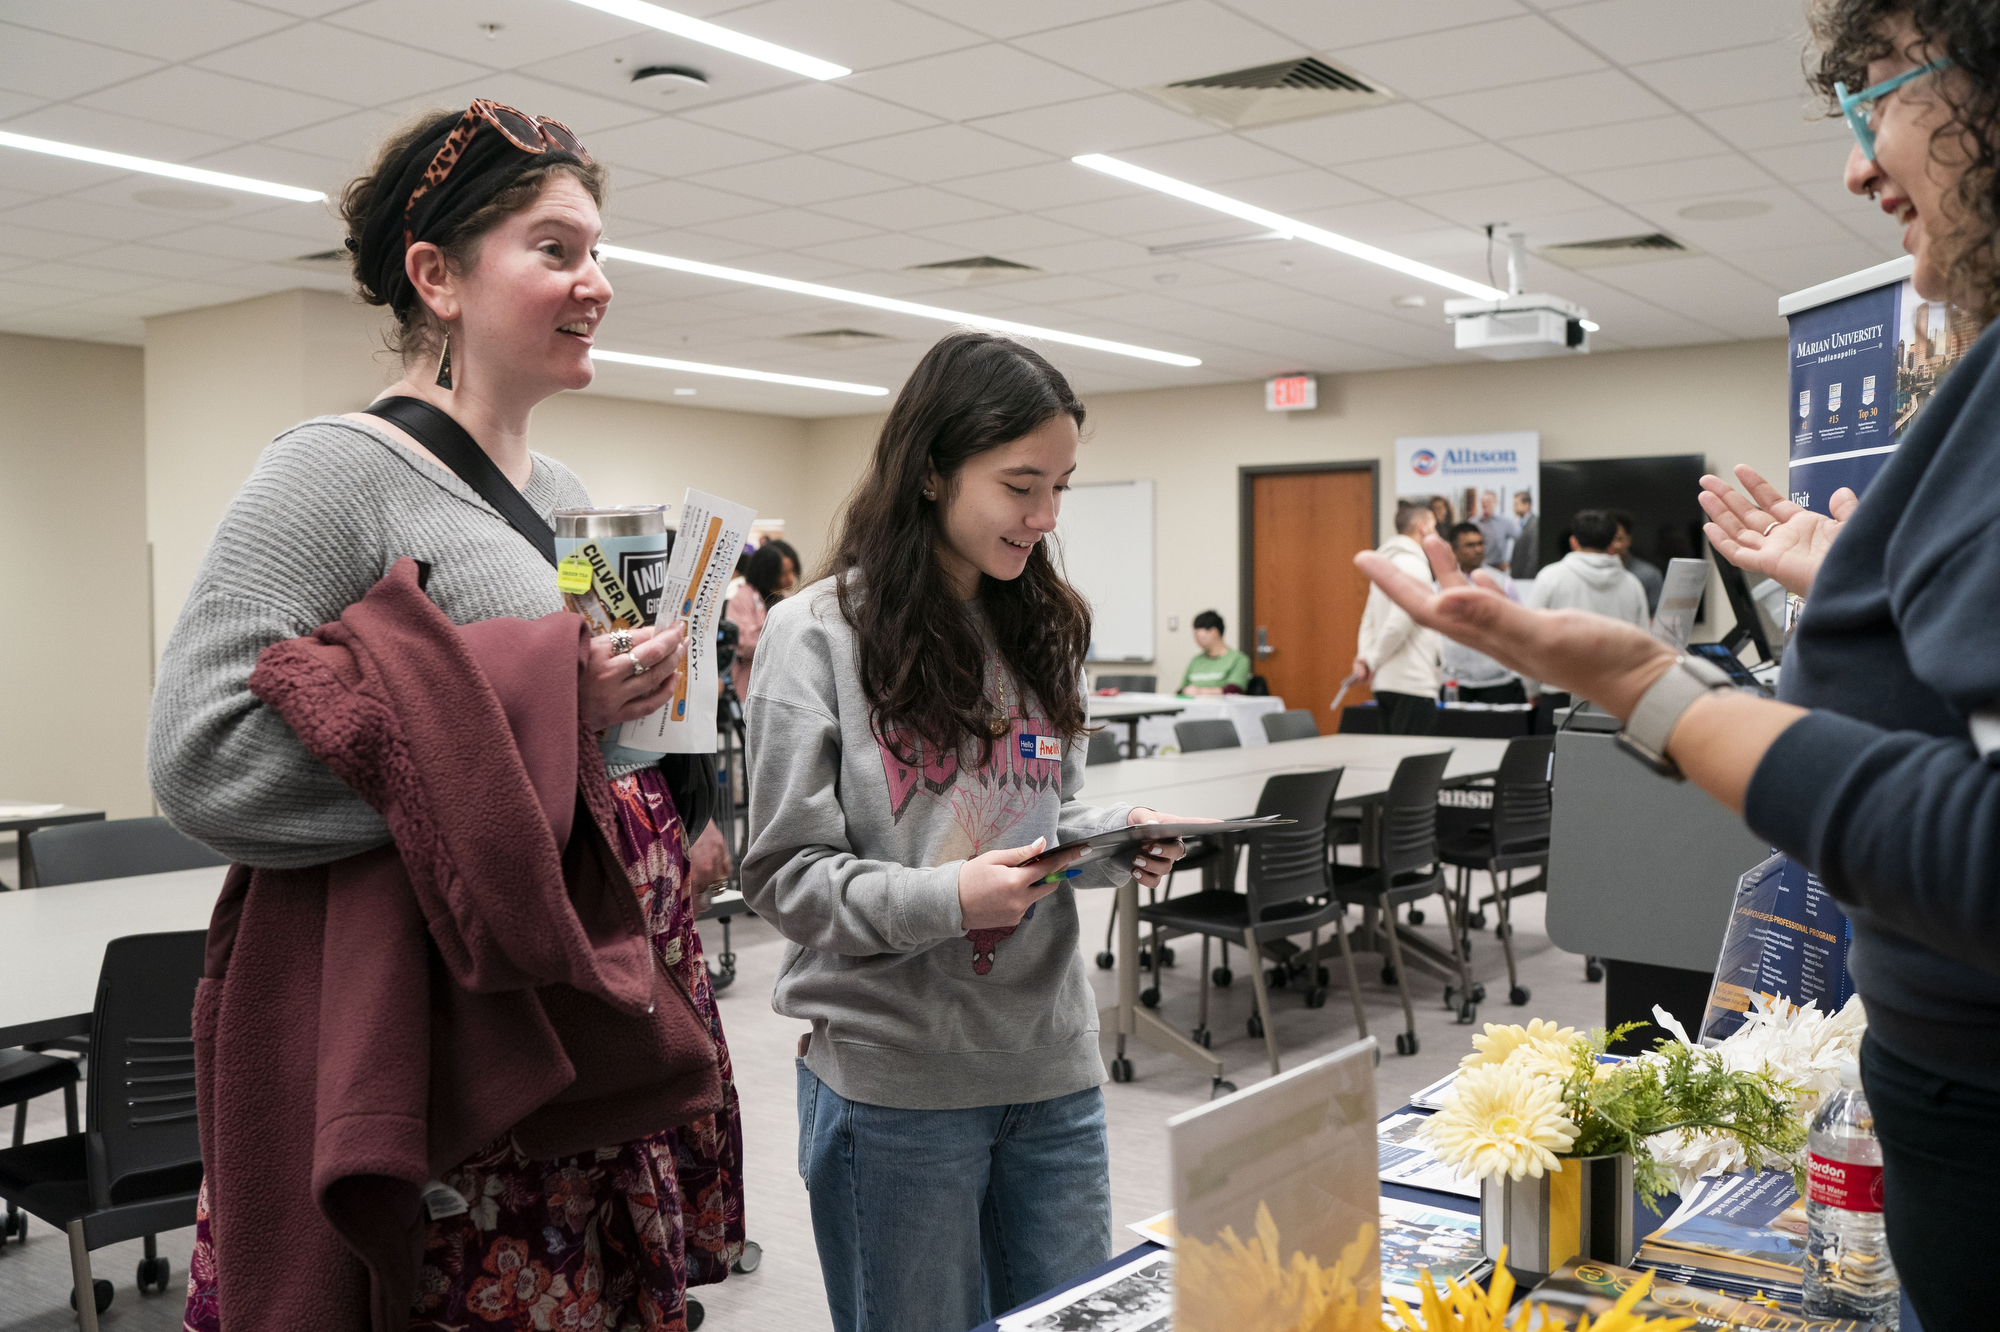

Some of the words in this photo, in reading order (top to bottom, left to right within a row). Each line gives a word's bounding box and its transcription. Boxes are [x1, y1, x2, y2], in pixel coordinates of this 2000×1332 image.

[1818, 348, 1857, 364] Indianapolis
[1274, 376, 1307, 407] EXIT
[1828, 414, 1839, 424] #15
[1858, 409, 1869, 420] Top
[1869, 406, 1879, 417] 30
[1443, 448, 1517, 464] Allison
[1791, 491, 1810, 508] Visit
[712, 531, 735, 583] CAREER
[583, 544, 625, 611] CULVER,
[621, 608, 641, 626] IN
[701, 587, 714, 617] FAIR
[1809, 927, 1837, 944] PROGRAMS
[1808, 1157, 1846, 1179] Gordon
[1826, 1185, 1848, 1197] Water
